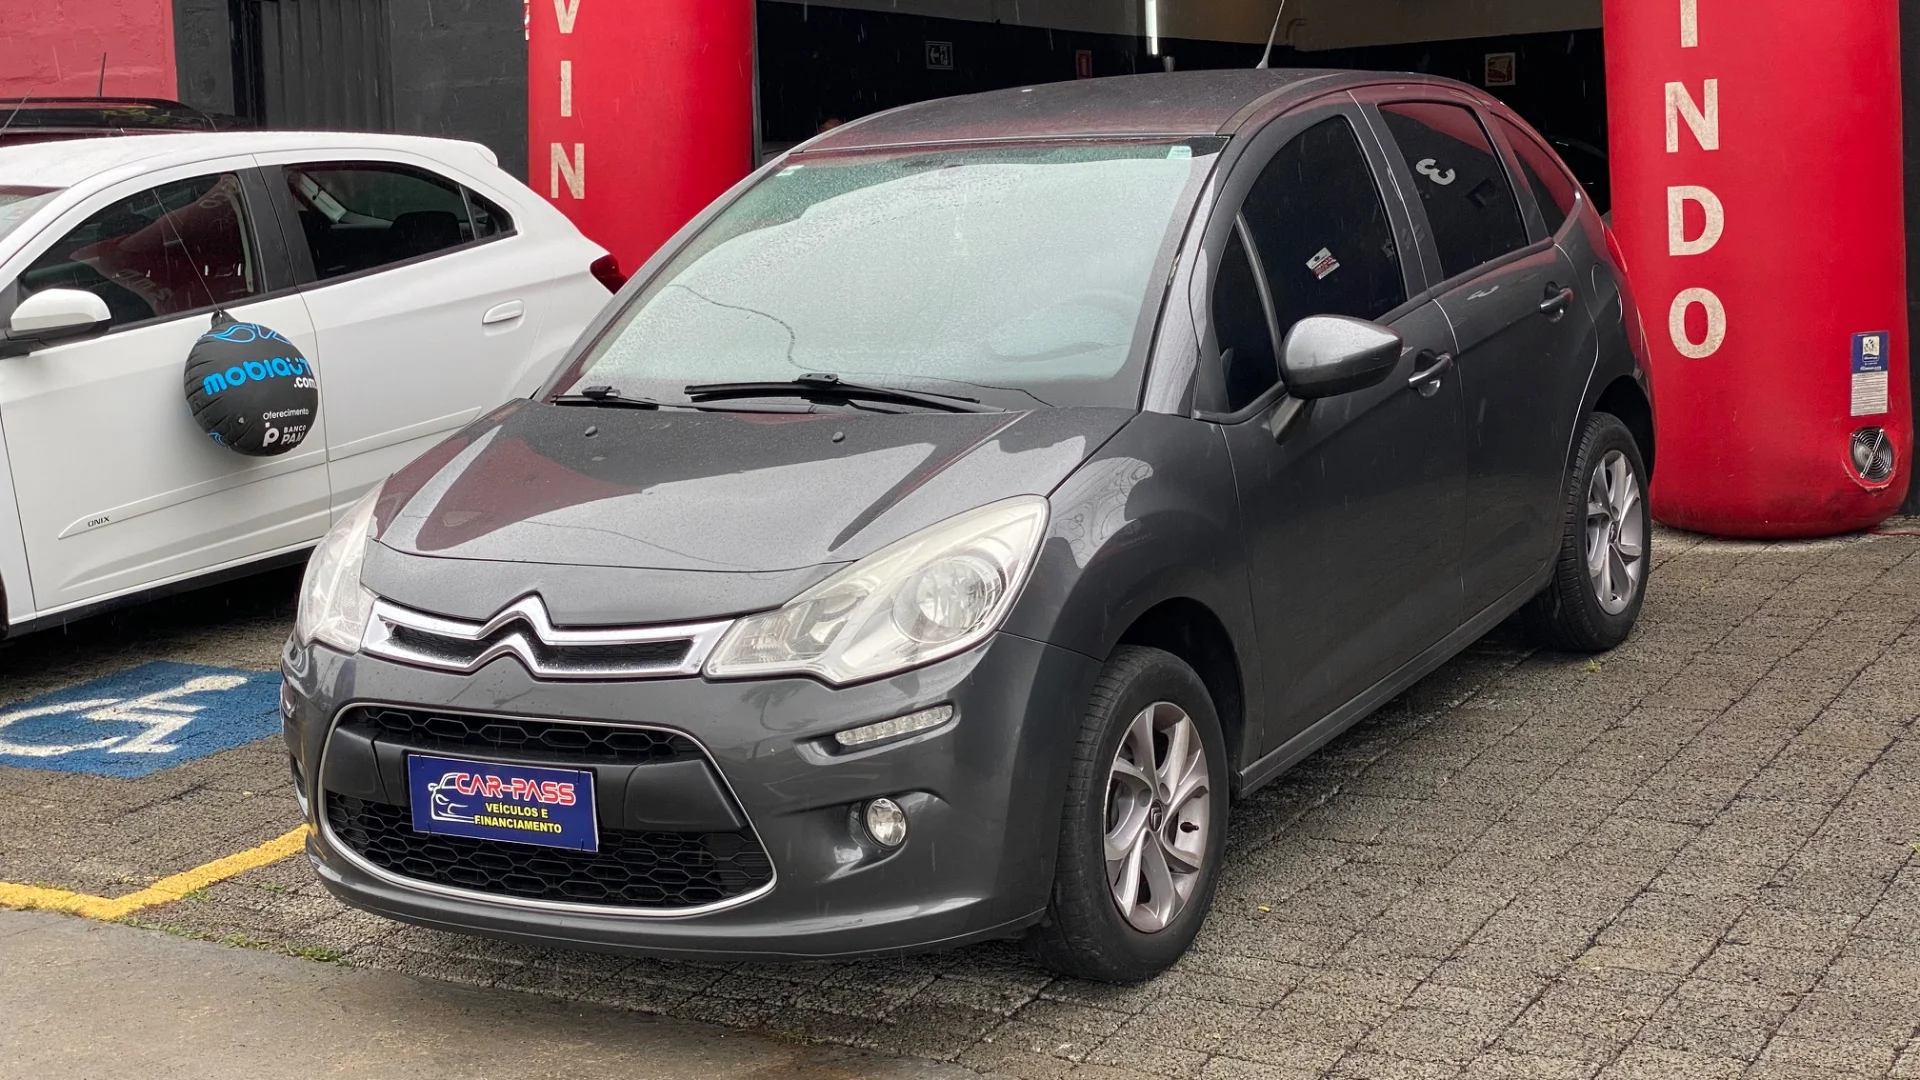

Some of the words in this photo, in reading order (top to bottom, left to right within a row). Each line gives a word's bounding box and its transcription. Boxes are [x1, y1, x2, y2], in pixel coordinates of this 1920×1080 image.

[203, 357, 311, 396] mobiaut
[262, 408, 310, 420] Oferecimento
[283, 425, 307, 433] BANCO
[87, 515, 110, 527] ONIX
[455, 772, 576, 806] CAR-PASS
[485, 802, 538, 818] VEÍCULOS
[541, 808, 549, 818] E
[474, 815, 563, 834] FINANCIAMENTO
